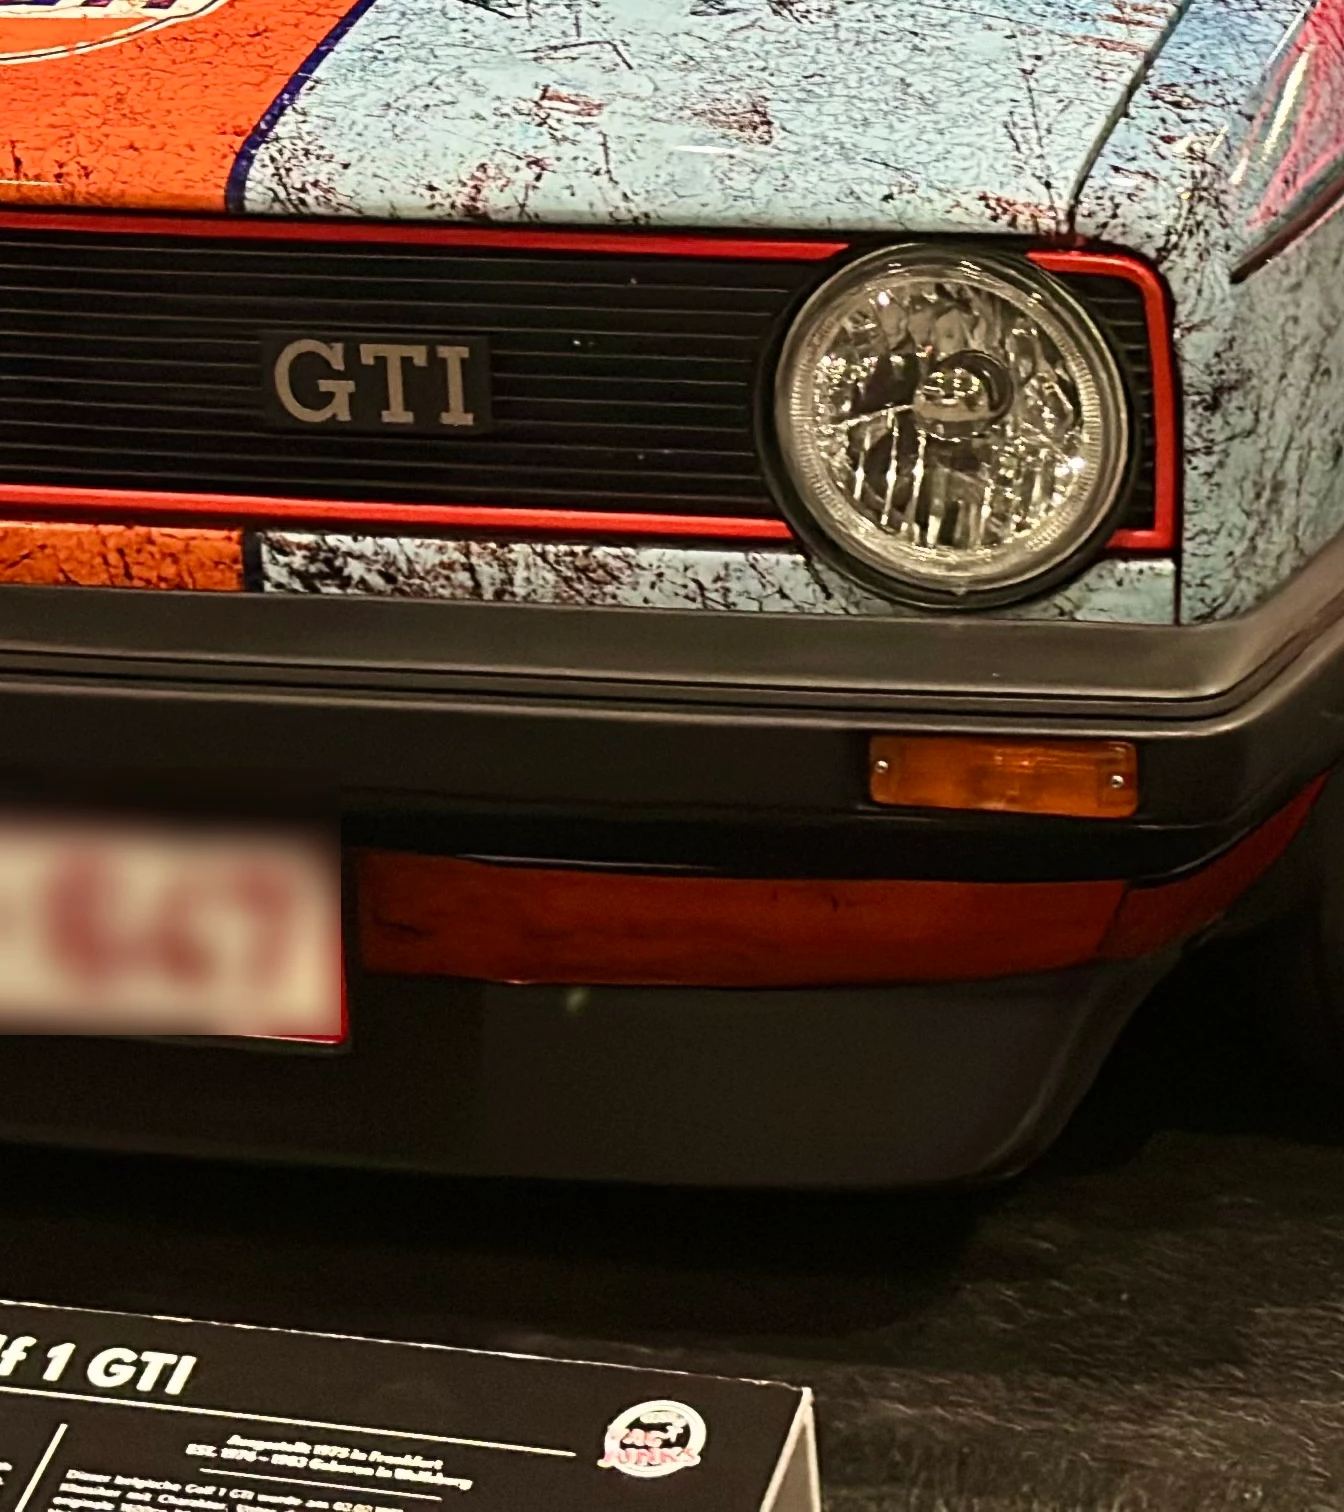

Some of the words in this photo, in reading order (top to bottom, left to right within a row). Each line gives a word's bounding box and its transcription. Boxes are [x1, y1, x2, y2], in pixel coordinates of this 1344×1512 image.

[272, 337, 475, 428] GTI
[42, 1342, 77, 1381] 1
[85, 1348, 198, 1396] GTI
